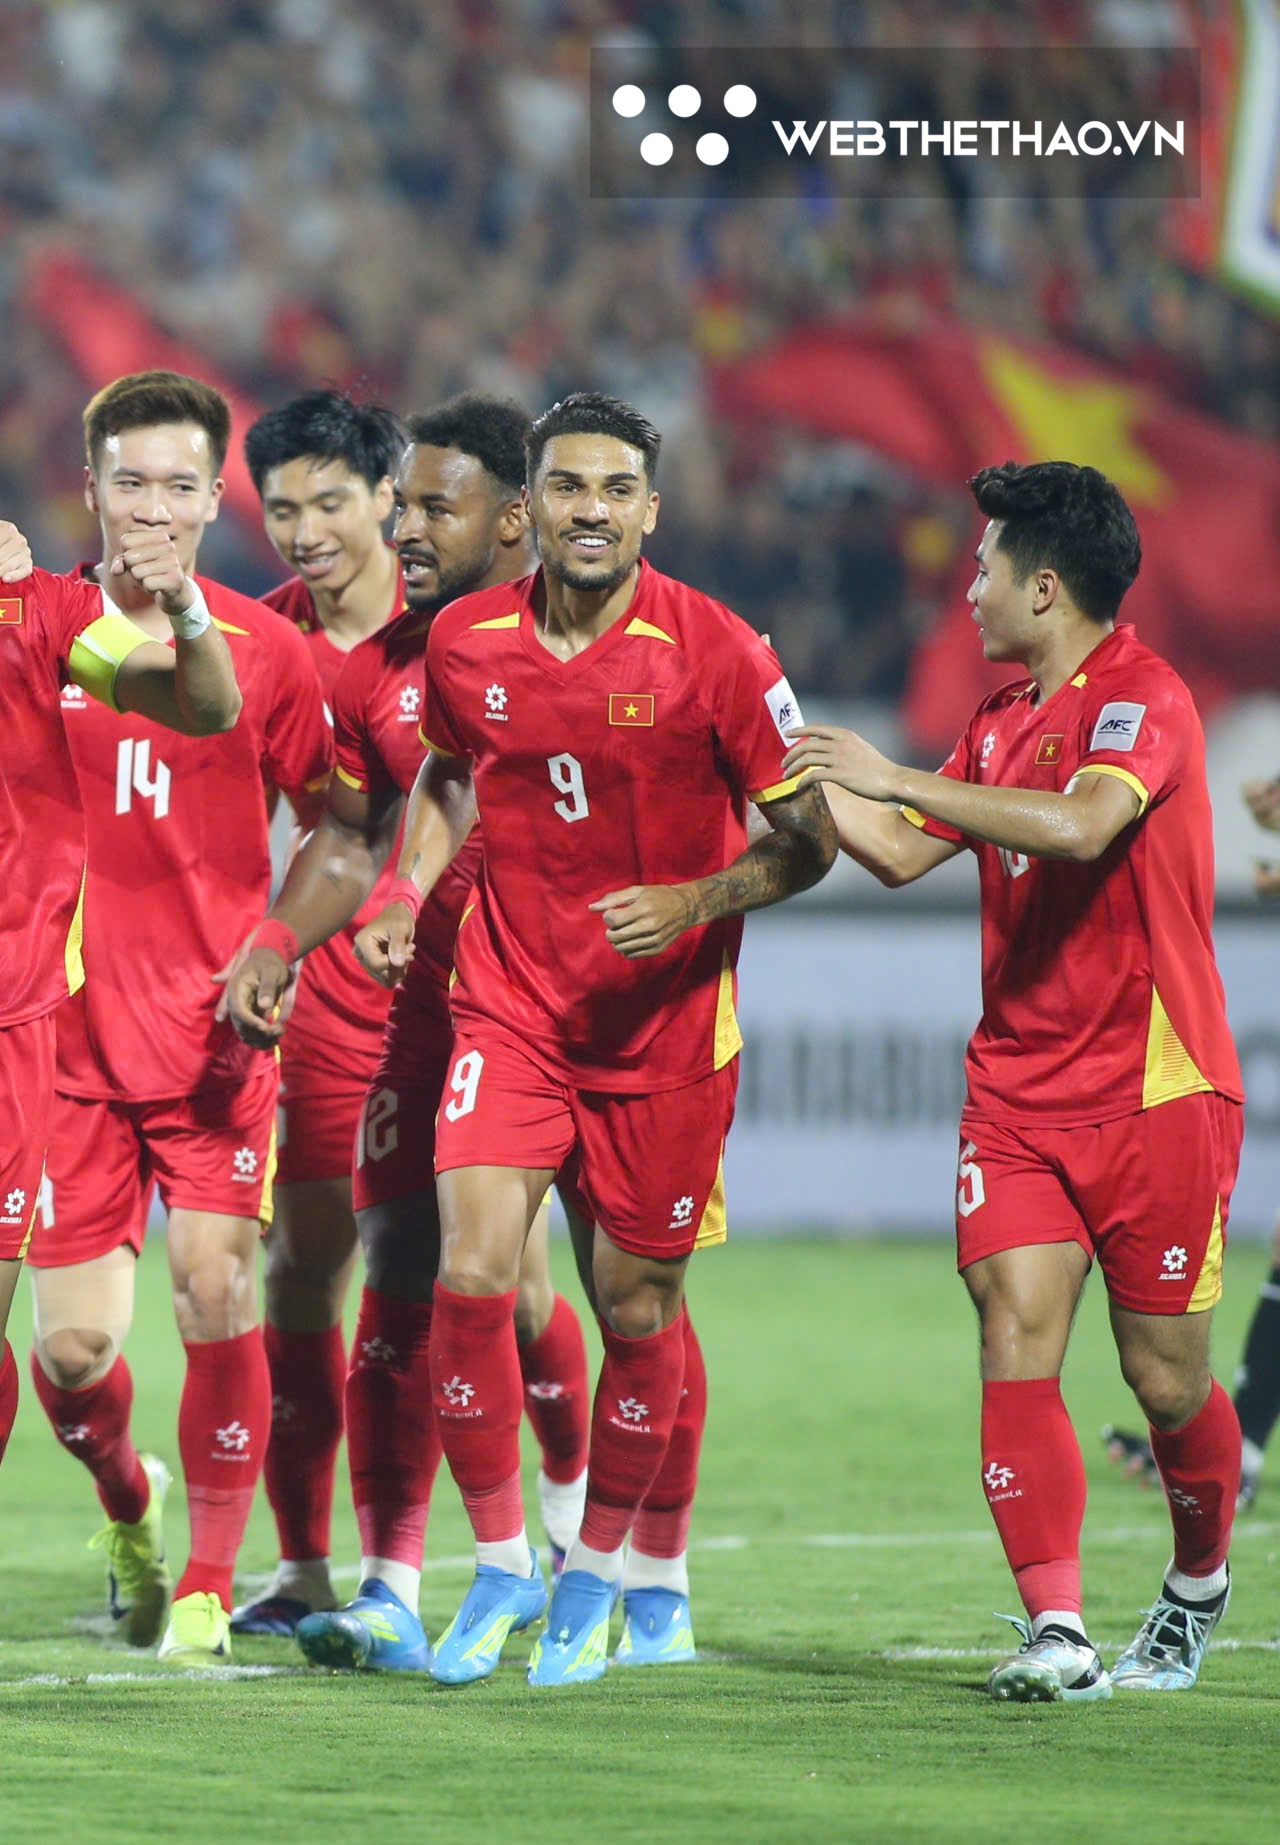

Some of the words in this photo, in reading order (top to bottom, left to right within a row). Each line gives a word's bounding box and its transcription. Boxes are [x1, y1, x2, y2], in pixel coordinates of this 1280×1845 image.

[1100, 720, 1136, 731] AFC
[116, 738, 171, 819] 14
[548, 753, 589, 823] 9
[445, 1050, 484, 1122] 9
